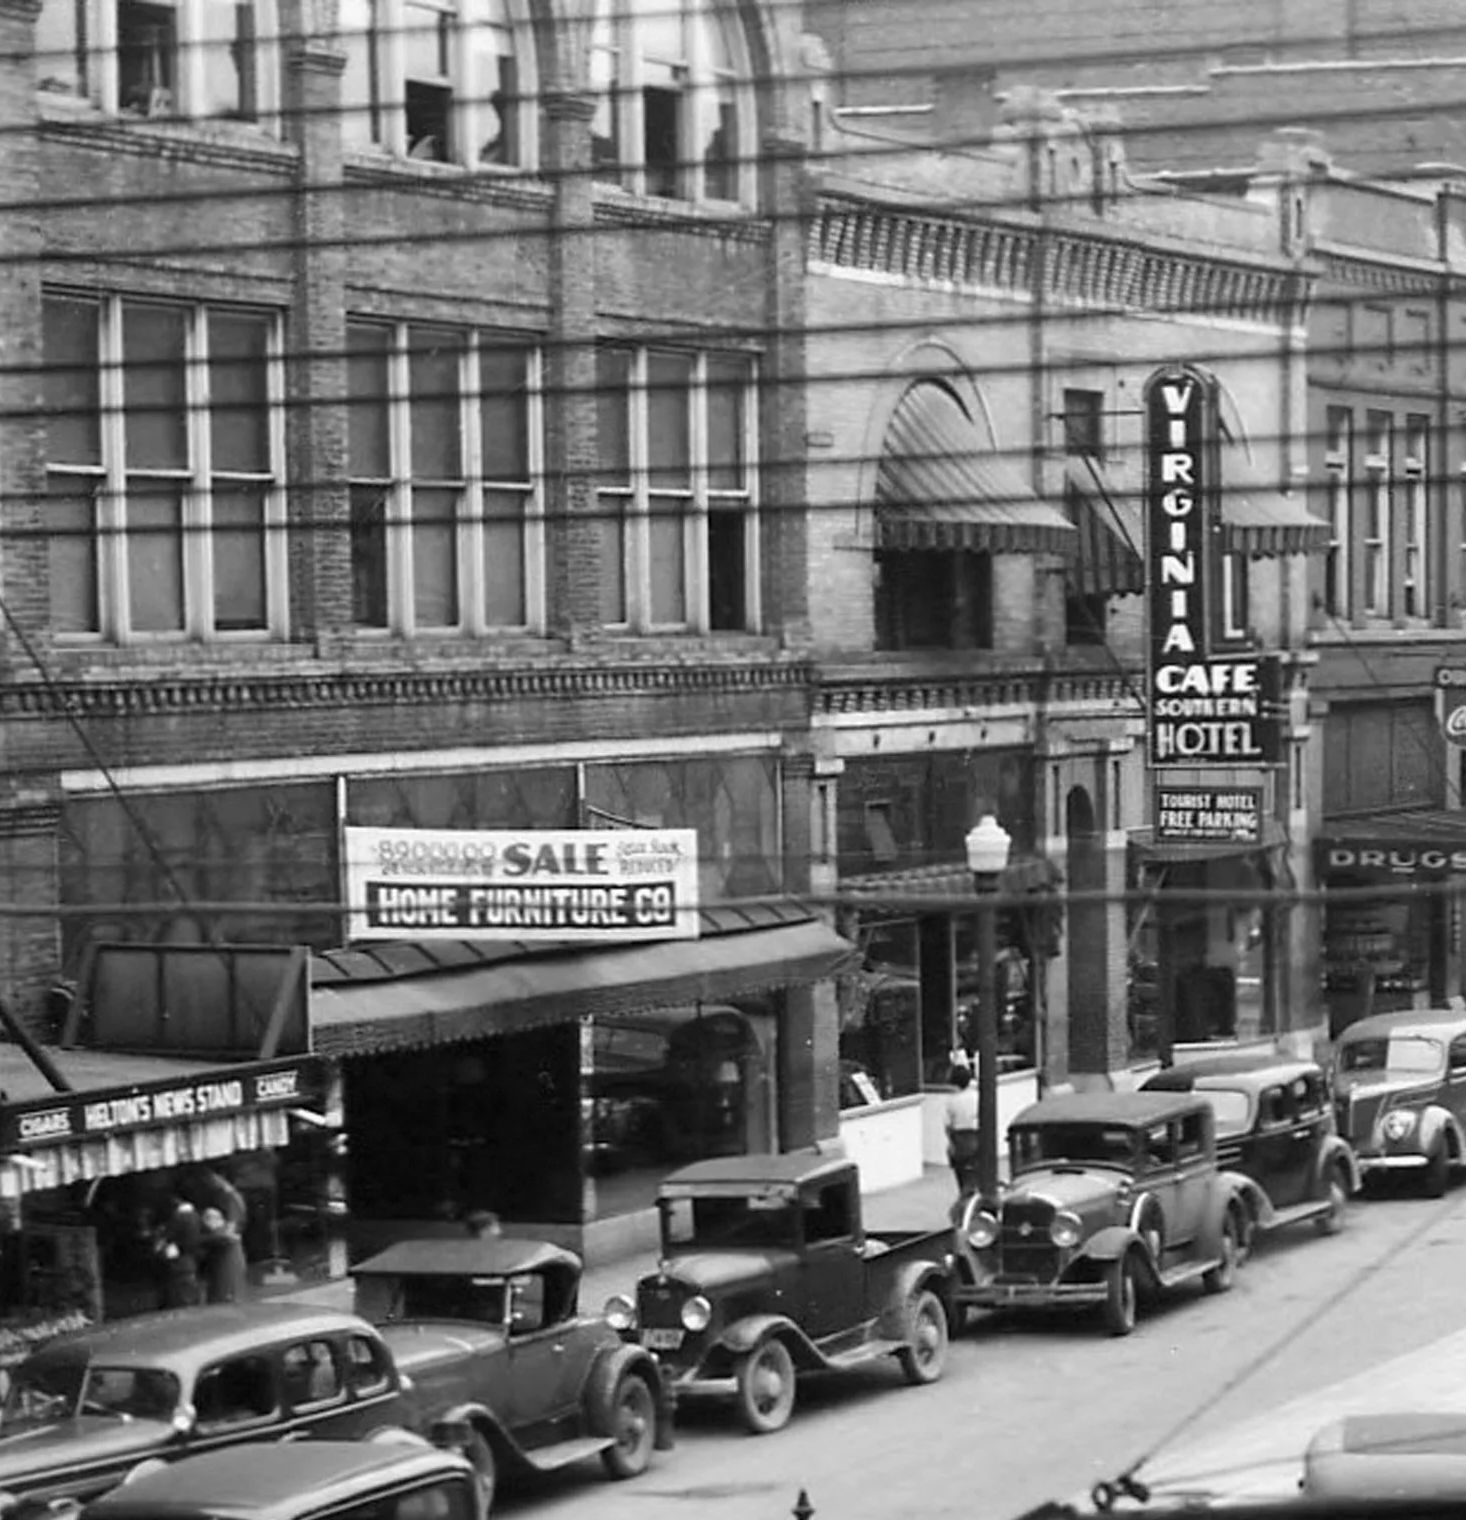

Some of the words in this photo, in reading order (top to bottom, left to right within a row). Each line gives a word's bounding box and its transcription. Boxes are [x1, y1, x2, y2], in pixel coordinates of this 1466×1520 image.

[1161, 384, 1195, 653] VIRGINIA
[1155, 664, 1258, 696] CAFE
[1155, 698, 1256, 717] SOUTHERN
[1157, 722, 1262, 758] HOTEL
[1161, 793, 1211, 808] TOURIST
[1216, 794, 1255, 809] HOTEL
[1160, 810, 1193, 828] FREE
[1198, 811, 1258, 828] PARKING
[502, 842, 609, 877] SALE
[378, 887, 458, 924] HOME
[470, 887, 627, 925] FURNITURE
[256, 1074, 297, 1097] CANDY
[84, 1095, 150, 1130] HELTON'S
[153, 1088, 194, 1118] NEWS
[196, 1080, 242, 1112] STAND
[19, 1111, 71, 1137] CIGARS
